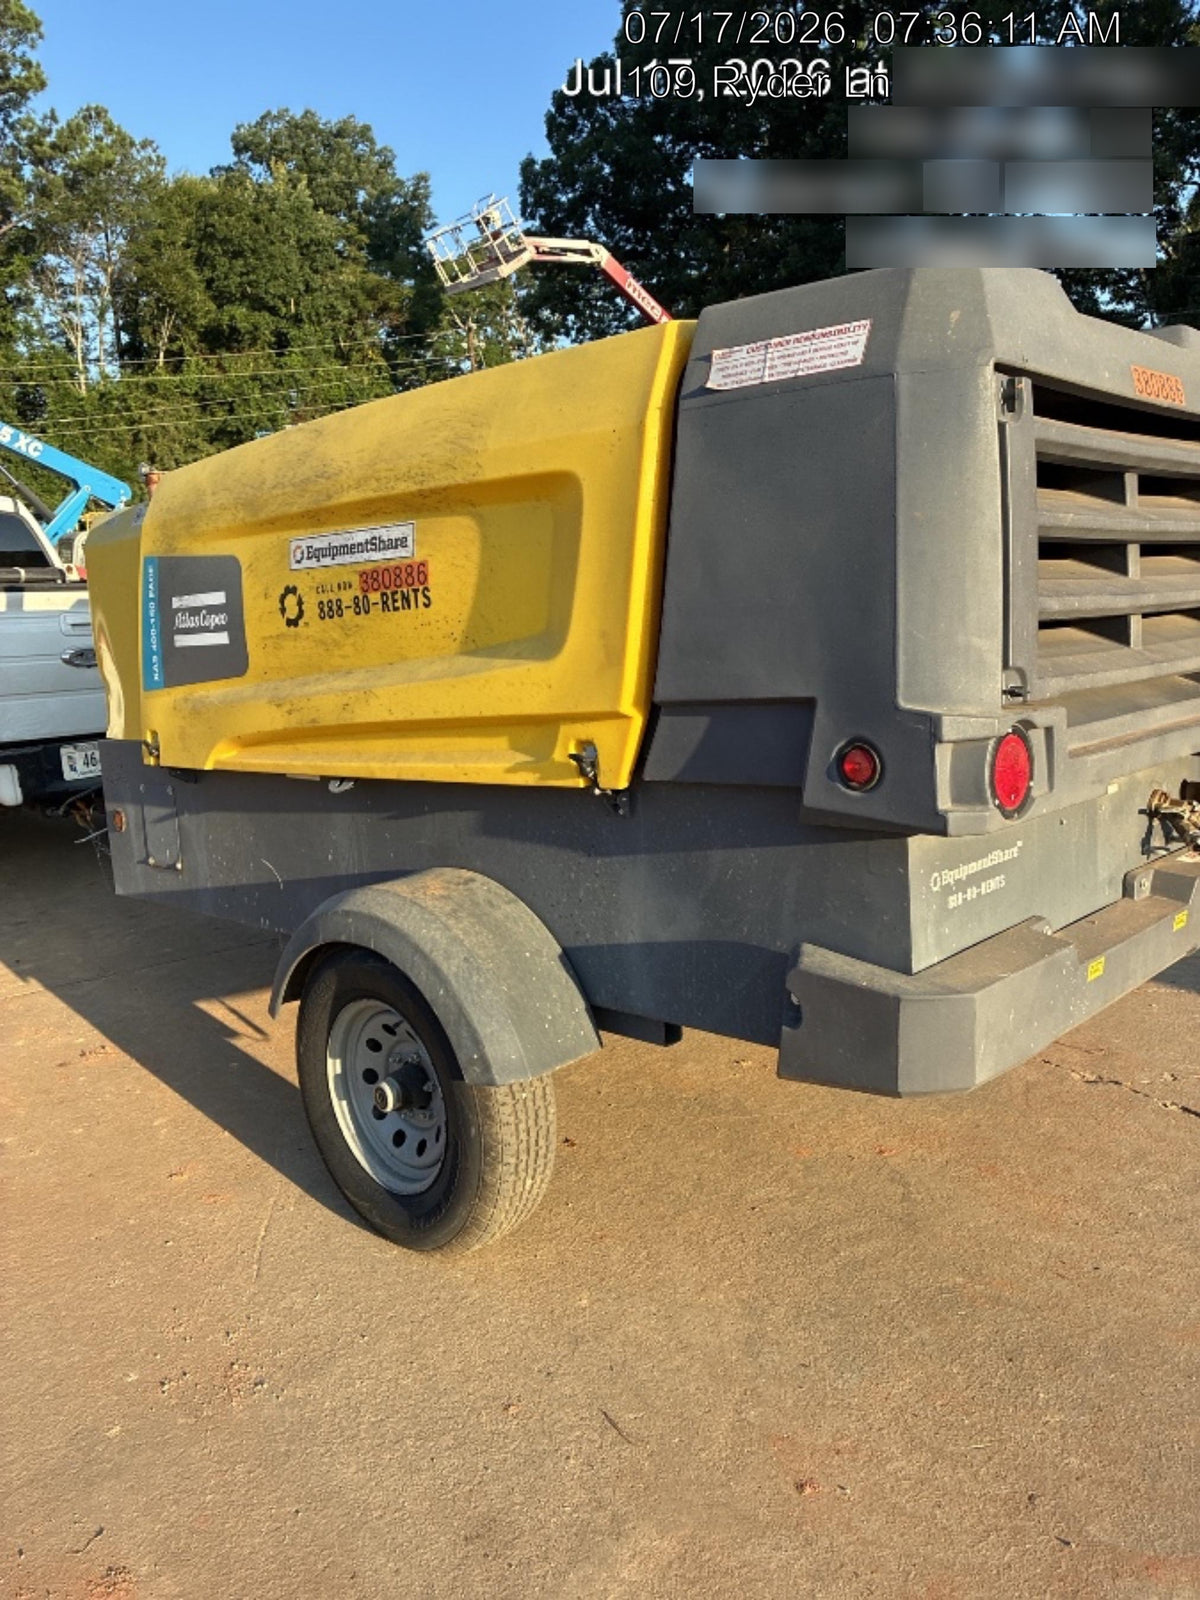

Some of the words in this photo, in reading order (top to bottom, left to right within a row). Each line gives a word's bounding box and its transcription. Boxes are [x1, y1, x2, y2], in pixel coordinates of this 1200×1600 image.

[13, 431, 44, 459] XC
[304, 535, 409, 563] EquipmentShare
[360, 563, 429, 593] 380886
[318, 587, 432, 620] 888-80-RENTS
[173, 610, 199, 631] Atlas
[200, 608, 228, 630] Copco
[941, 846, 1019, 886] EquipmentShare
